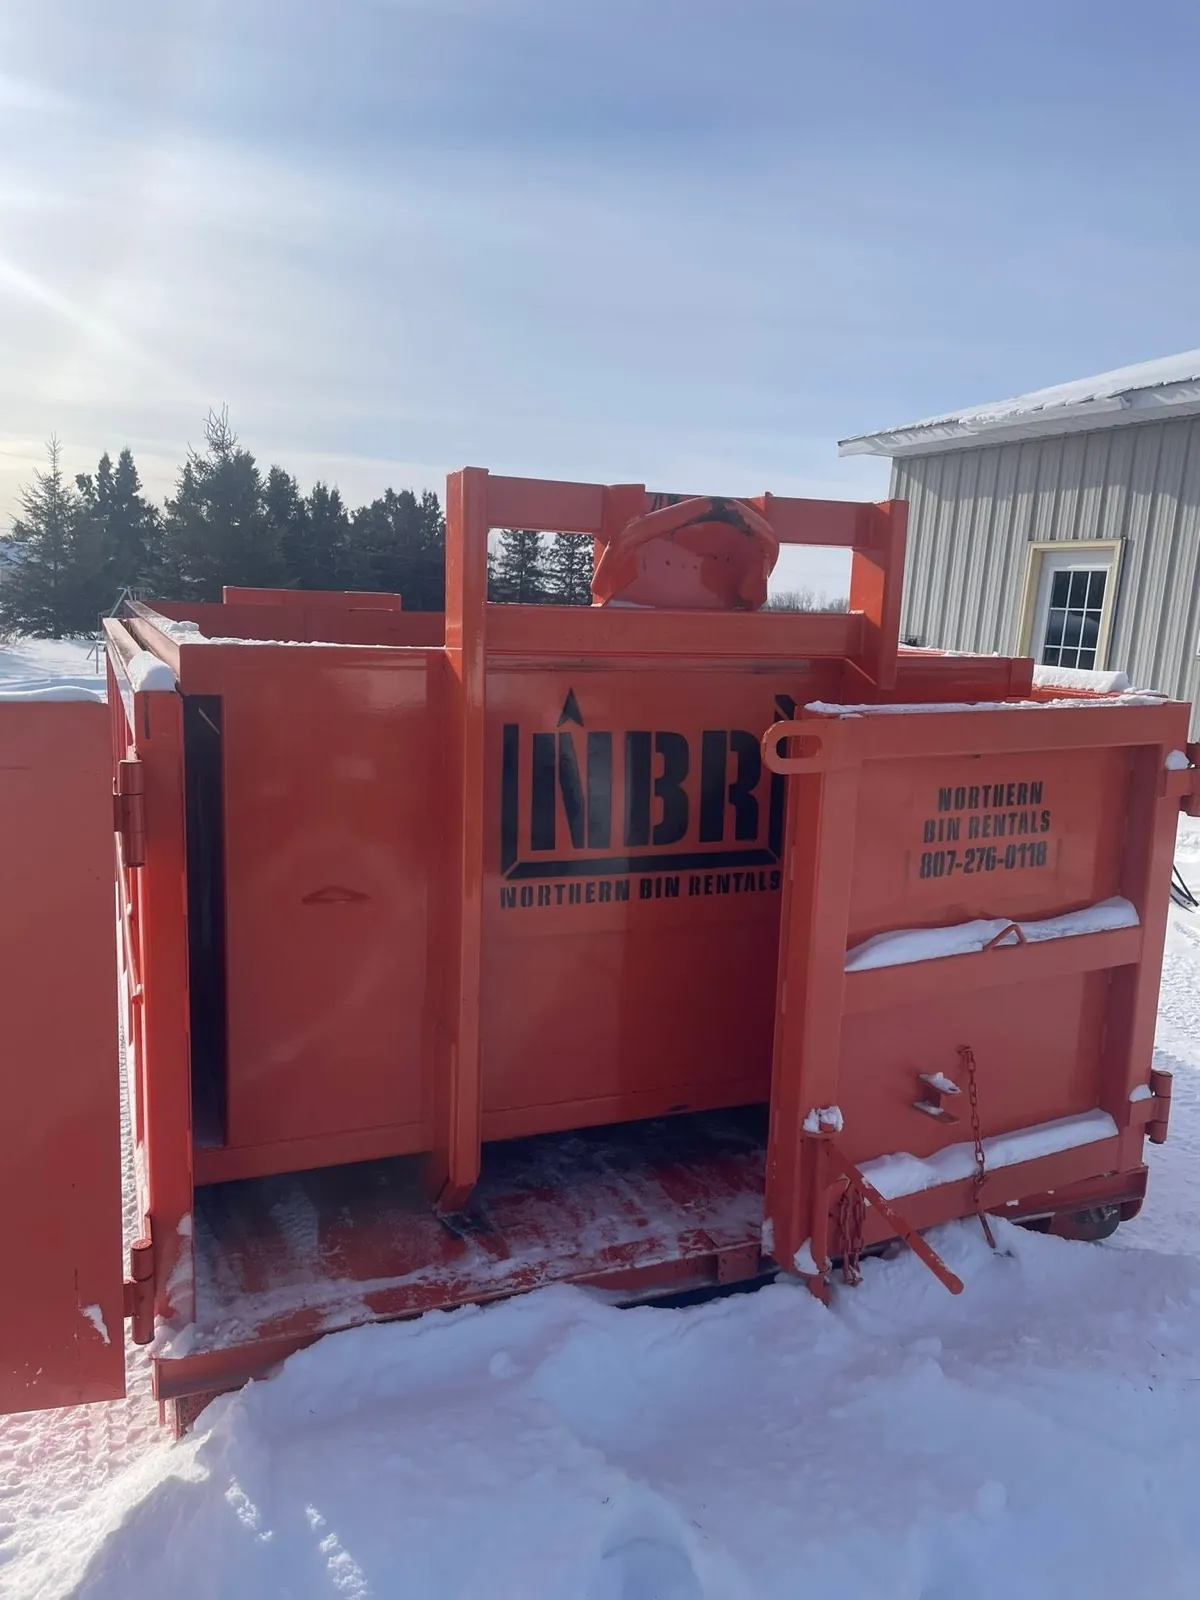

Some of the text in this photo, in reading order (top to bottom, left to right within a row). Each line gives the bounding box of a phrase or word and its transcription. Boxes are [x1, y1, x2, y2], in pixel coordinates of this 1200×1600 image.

[530, 730, 762, 851] NBR
[938, 781, 1043, 812] NORTHERN
[923, 809, 1051, 843] BIN RENTALS
[919, 840, 1048, 880] 807-276-0118
[500, 870, 781, 909] NORTHERN BIN RENTALS
